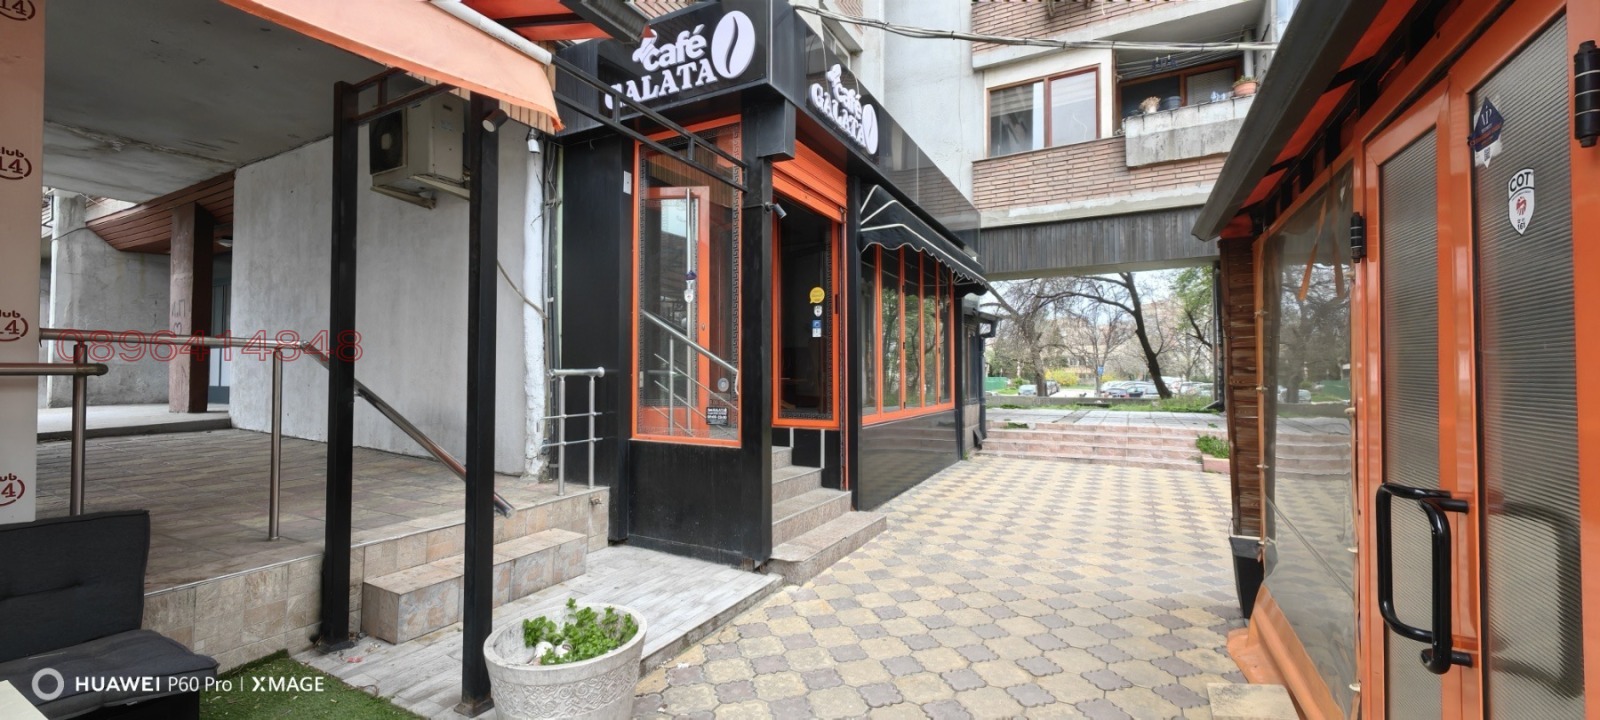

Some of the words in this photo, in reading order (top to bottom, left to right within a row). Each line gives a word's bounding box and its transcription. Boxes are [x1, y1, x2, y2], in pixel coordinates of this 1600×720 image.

[642, 24, 708, 72] café
[833, 83, 863, 120] café
[809, 83, 867, 148] GALATA
[0, 146, 25, 158] lub
[0, 319, 20, 335] 4
[0, 482, 17, 498] 4
